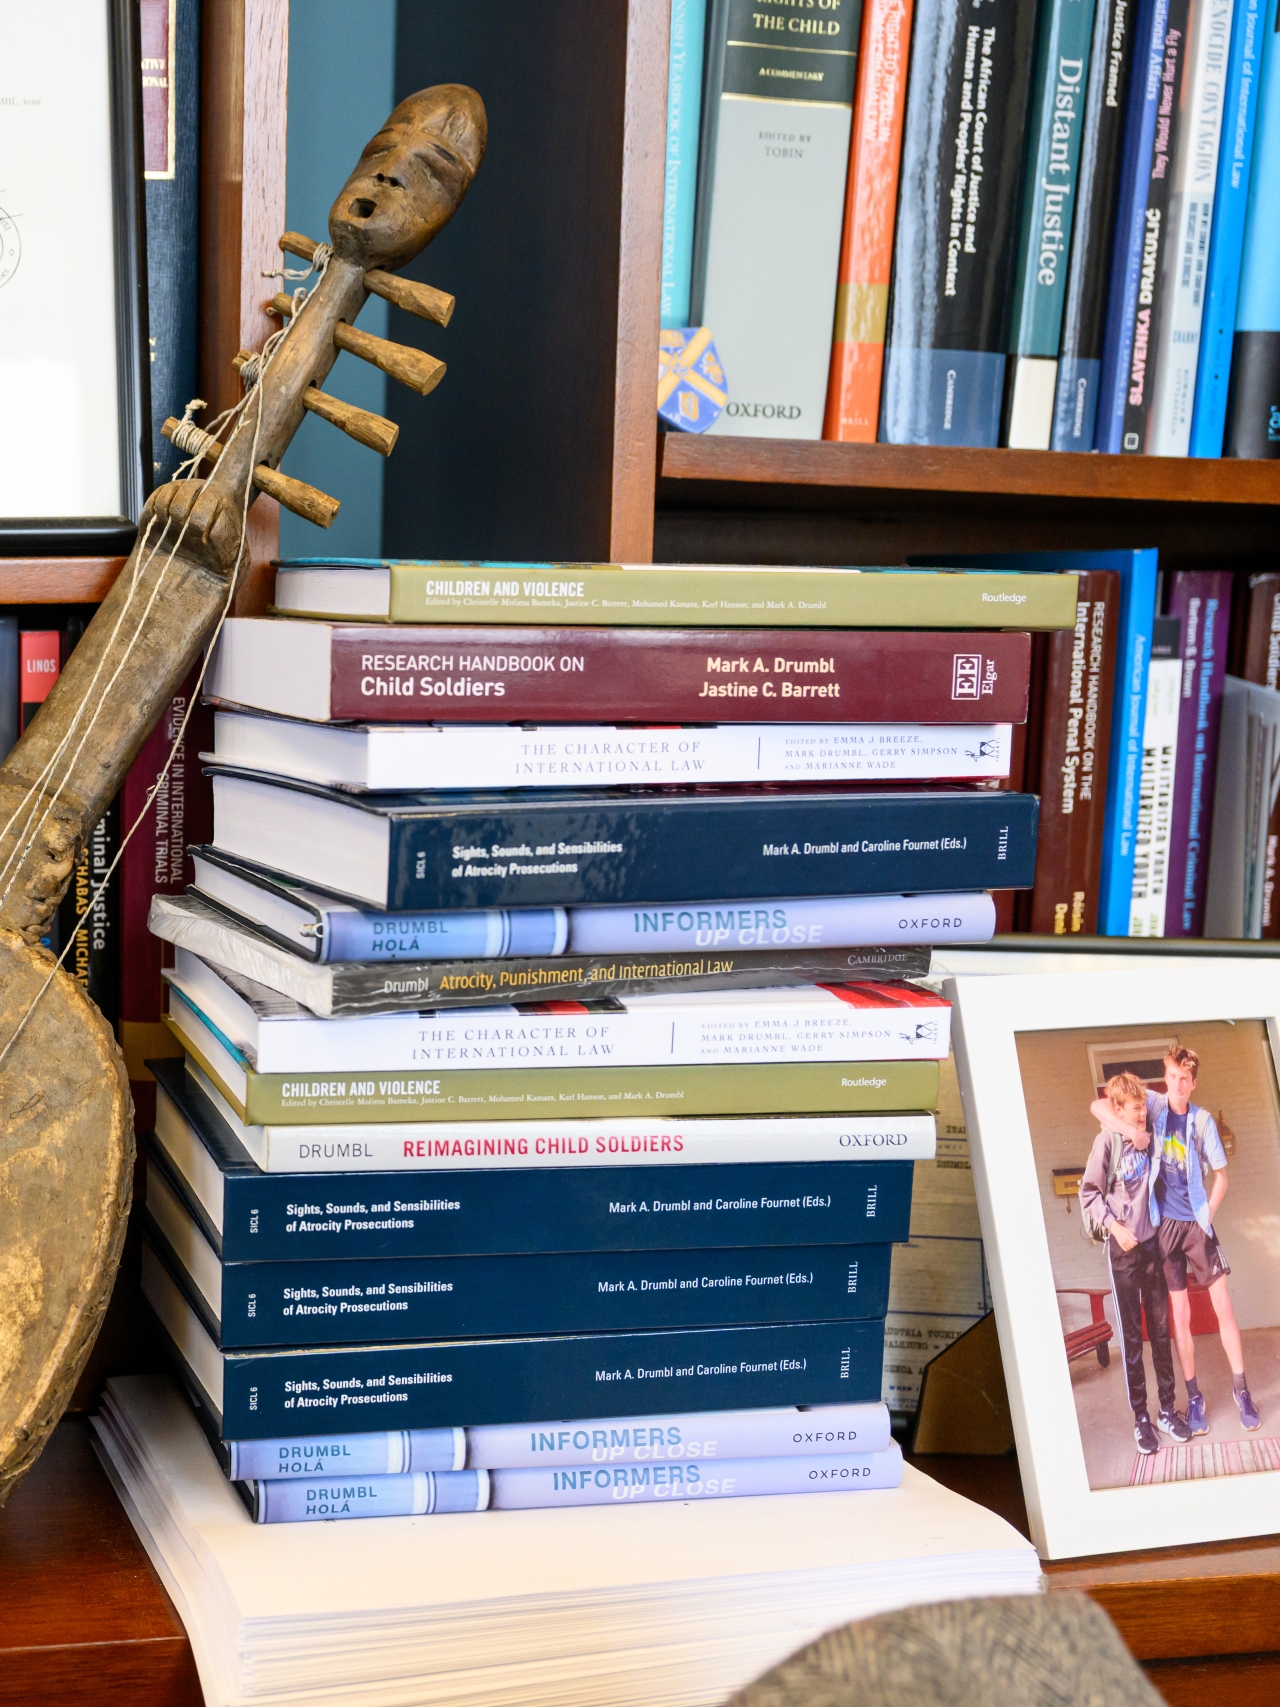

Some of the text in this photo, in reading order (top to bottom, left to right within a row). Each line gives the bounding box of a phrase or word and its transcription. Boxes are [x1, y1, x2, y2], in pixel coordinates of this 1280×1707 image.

[753, 13, 840, 35] THE CHILD
[764, 146, 804, 158] TOBIN
[1038, 56, 1083, 286] Distant Justice
[1139, 208, 1161, 304] DRAKULIĆ
[1129, 309, 1151, 406] SLAVENKA
[726, 402, 801, 420] OXFORD
[425, 580, 585, 597] CHILDREN AND VIOLENCE
[981, 592, 1027, 605] Routledge
[27, 659, 56, 673] LINOS
[361, 655, 585, 672] RESEARCH HANDBOOK ON
[707, 657, 835, 673] Mark A. Drumbl
[981, 659, 997, 695] Elgar
[361, 677, 505, 696] Child Soldiers
[698, 681, 840, 699] Jastine C. Barrett
[1061, 602, 1090, 814] International Penal System
[521, 741, 701, 755] THE CHARACTER OF
[785, 746, 958, 758] MARK DRUMBL, GERRY SIMPSON
[515, 760, 706, 774] INTERNATIONAL LAW
[170, 697, 185, 884] EVIDENCE IN INTERNATIONAL
[154, 772, 170, 884] CRIMINAL TRIALS
[373, 920, 449, 936] DRUMBL
[634, 909, 787, 933] INFORMERS
[898, 917, 962, 930] OXFORD
[695, 925, 823, 947] UP CLOSE
[372, 938, 420, 953] HOLÁ
[847, 953, 908, 966] CAMBRIDGE
[384, 959, 734, 994] Drumbl Atrocity, Punishment, and International Law
[299, 1133, 908, 1158] DRUMBL REIMAGINING CHILD SOLDIERS OXFORD
[286, 1199, 460, 1217] Sights, Sounds, and Sensibilities
[609, 1195, 831, 1213] Mark A. Drumbl and Caroline Fournet (Eds.)
[866, 1184, 878, 1218] BRILL
[286, 1217, 414, 1233] of Atrocity Prosecutions
